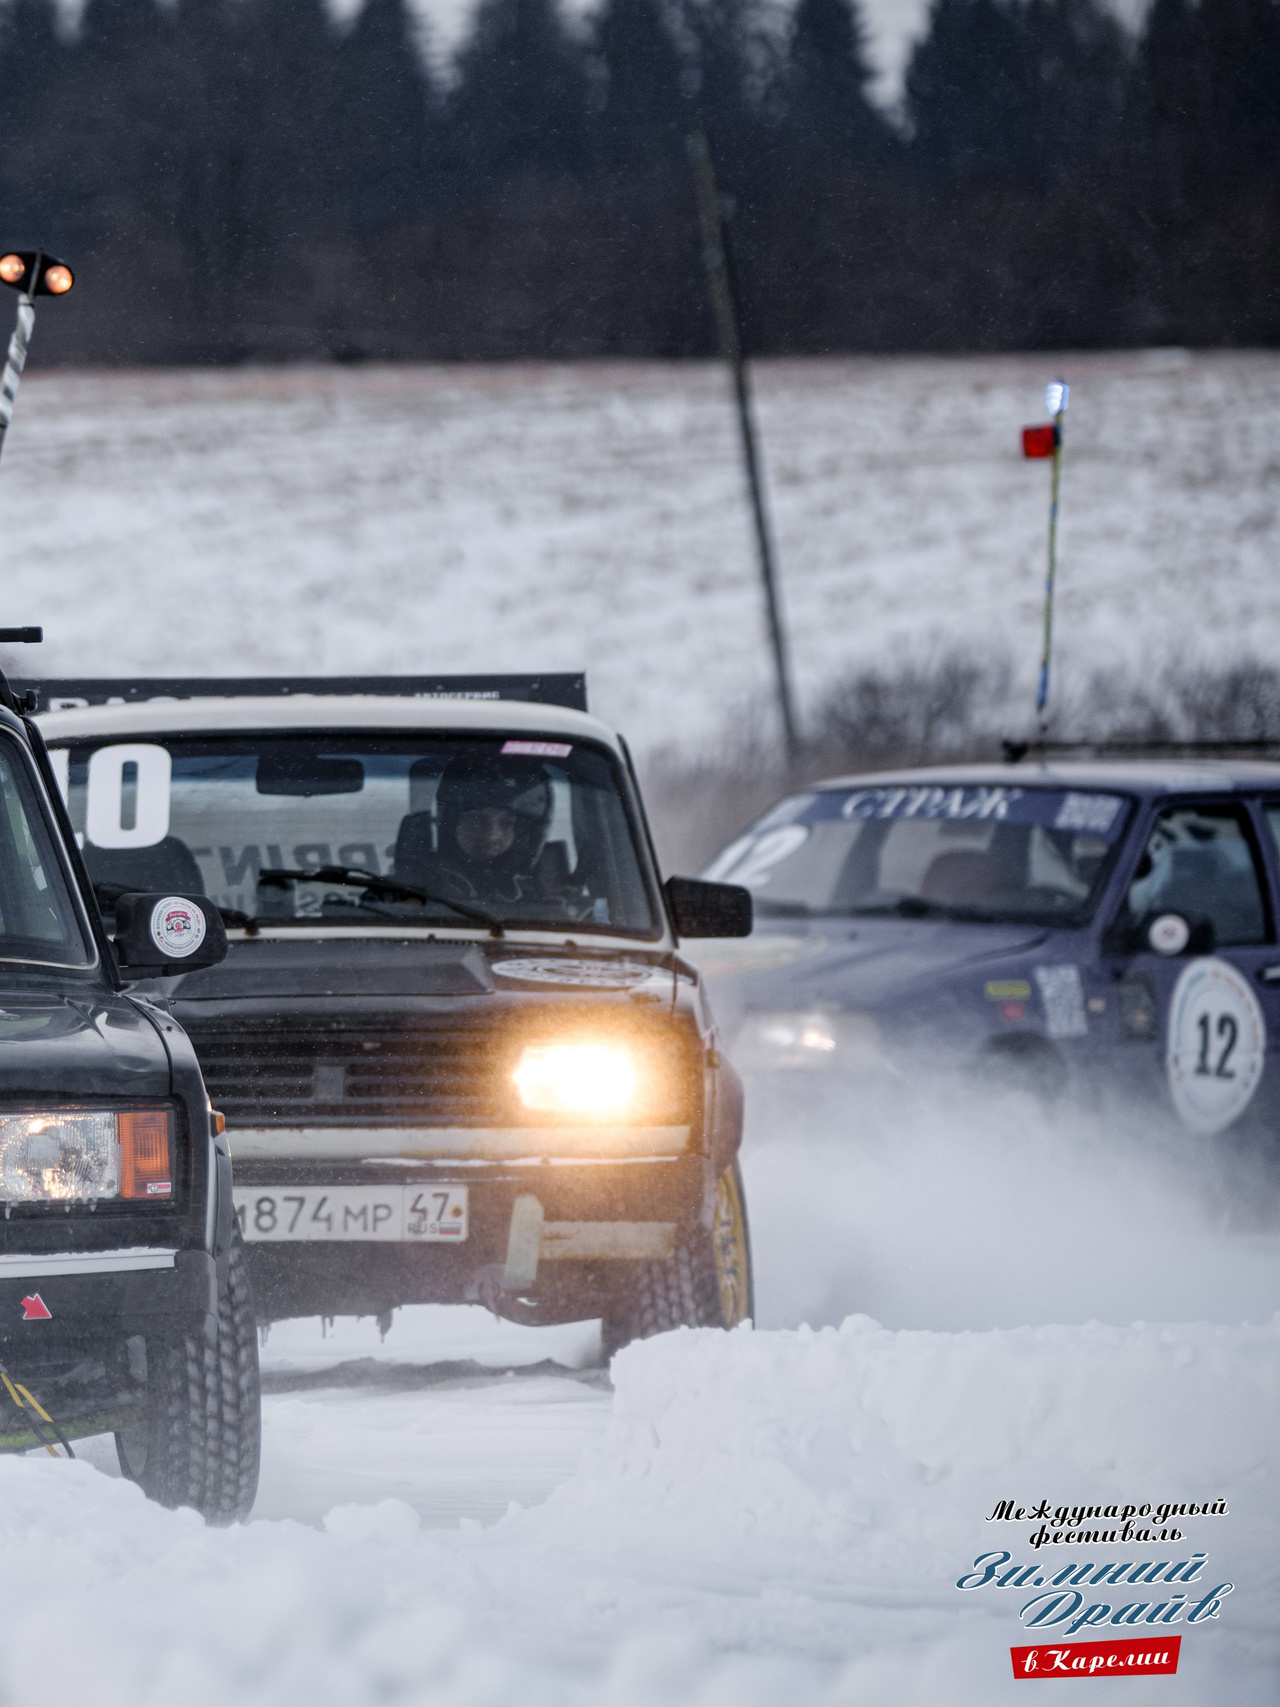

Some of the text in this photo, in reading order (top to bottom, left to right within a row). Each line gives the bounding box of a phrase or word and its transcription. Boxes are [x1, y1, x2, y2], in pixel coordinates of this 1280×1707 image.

[1194, 1011, 1239, 1079] 12
[410, 1192, 450, 1223] 47
[408, 1223, 438, 1233] RUS
